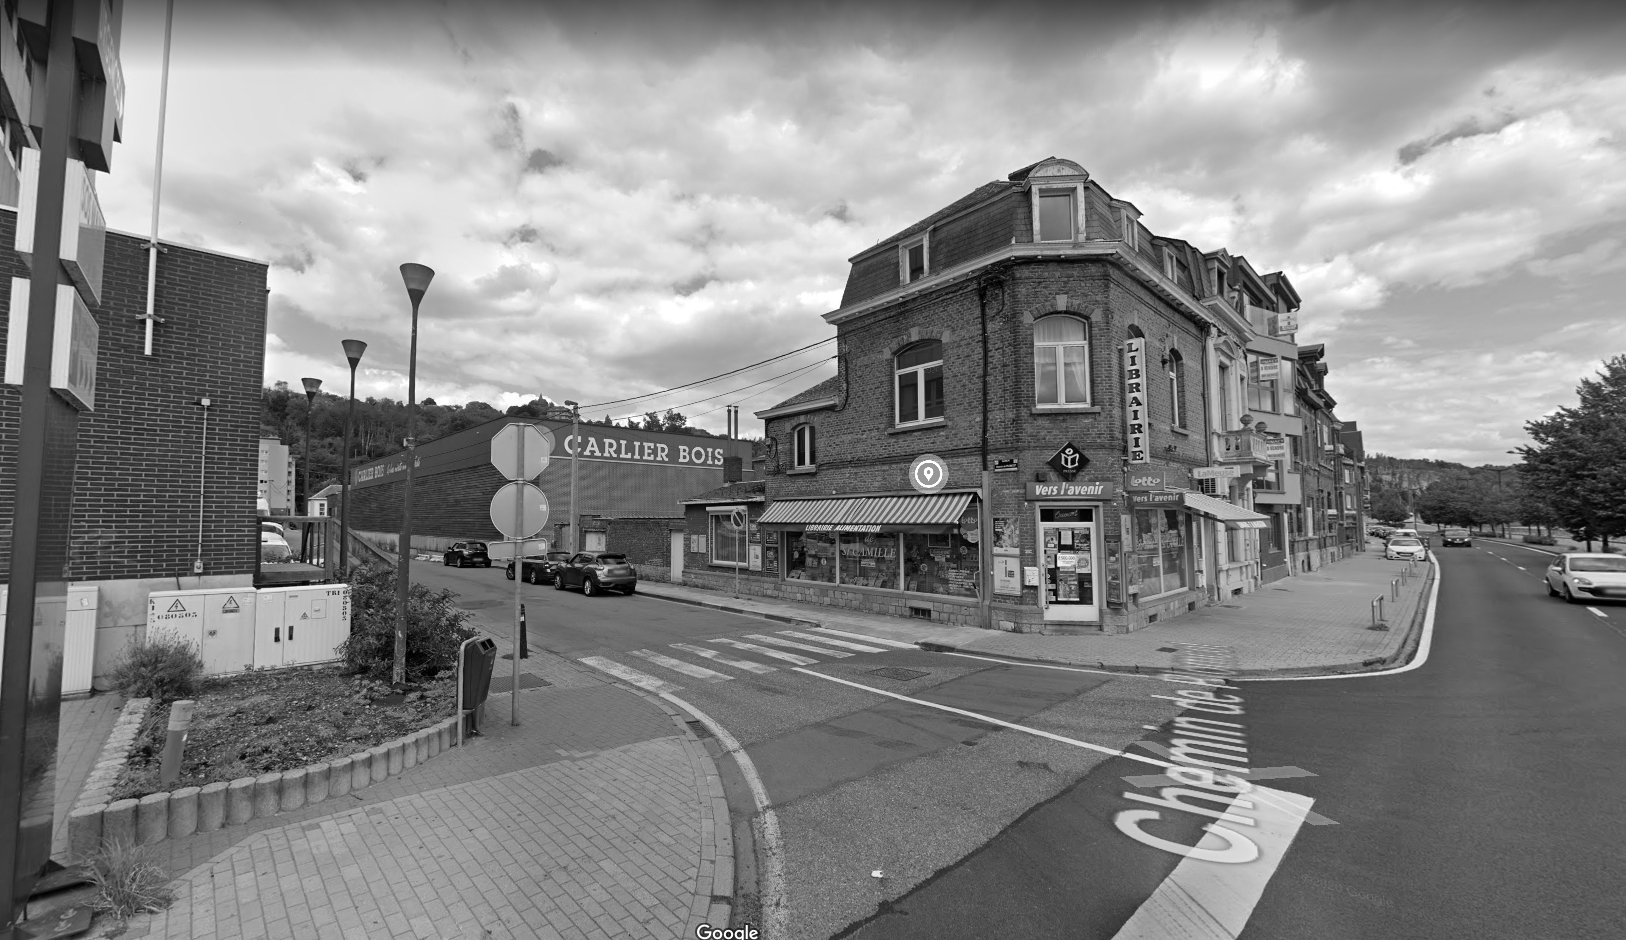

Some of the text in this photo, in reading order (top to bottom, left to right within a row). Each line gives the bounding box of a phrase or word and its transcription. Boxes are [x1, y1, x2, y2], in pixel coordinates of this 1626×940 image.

[1126, 342, 1144, 461] LIBRAIRIE
[563, 434, 724, 466] CARLIER BOIS
[374, 464, 385, 479] BOIS
[1035, 481, 1104, 496] Vers l'avenir
[1149, 492, 1180, 502] l'avenir
[834, 524, 882, 532] ALIMENTATION
[852, 547, 897, 558] CAMILLE
[157, 611, 198, 620] 080505
